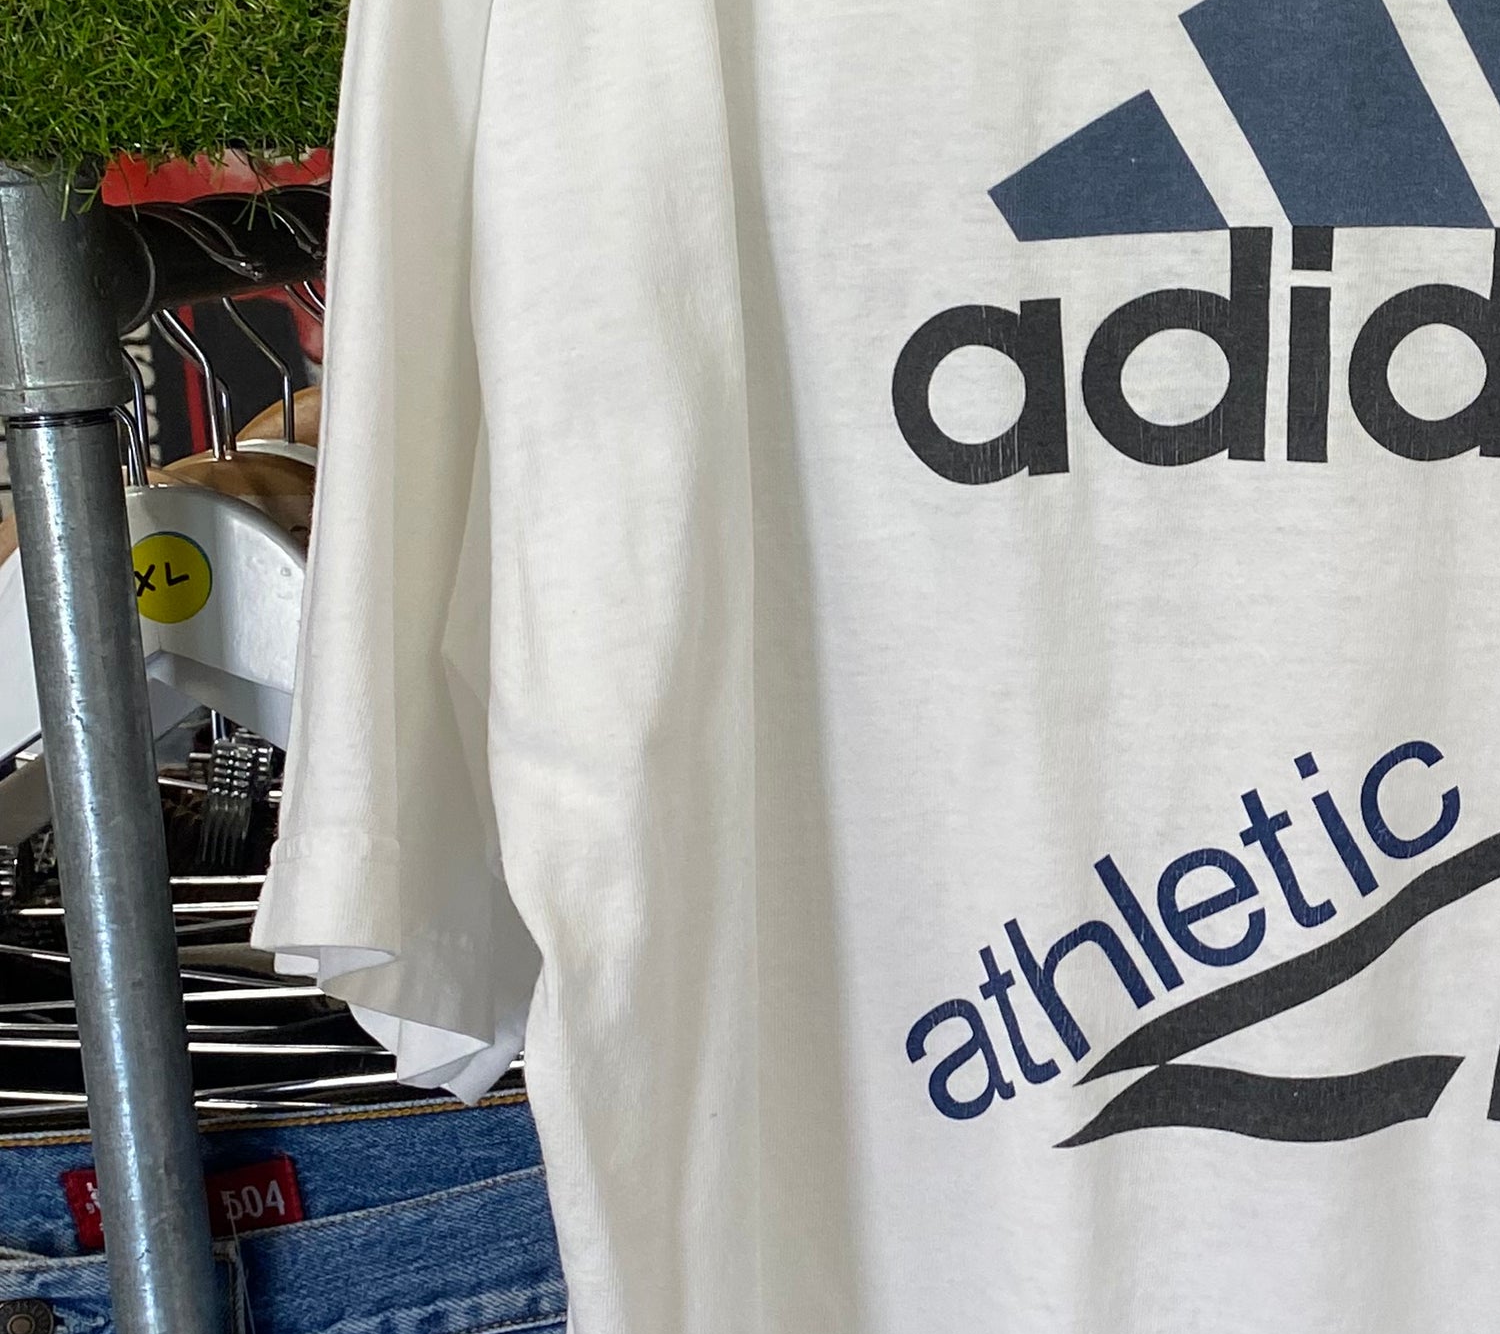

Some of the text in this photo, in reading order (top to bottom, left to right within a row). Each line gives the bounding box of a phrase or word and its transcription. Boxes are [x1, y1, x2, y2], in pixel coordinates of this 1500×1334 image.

[134, 562, 190, 597] XL
[905, 740, 1461, 1121] athletic
[220, 1179, 286, 1221] 504
